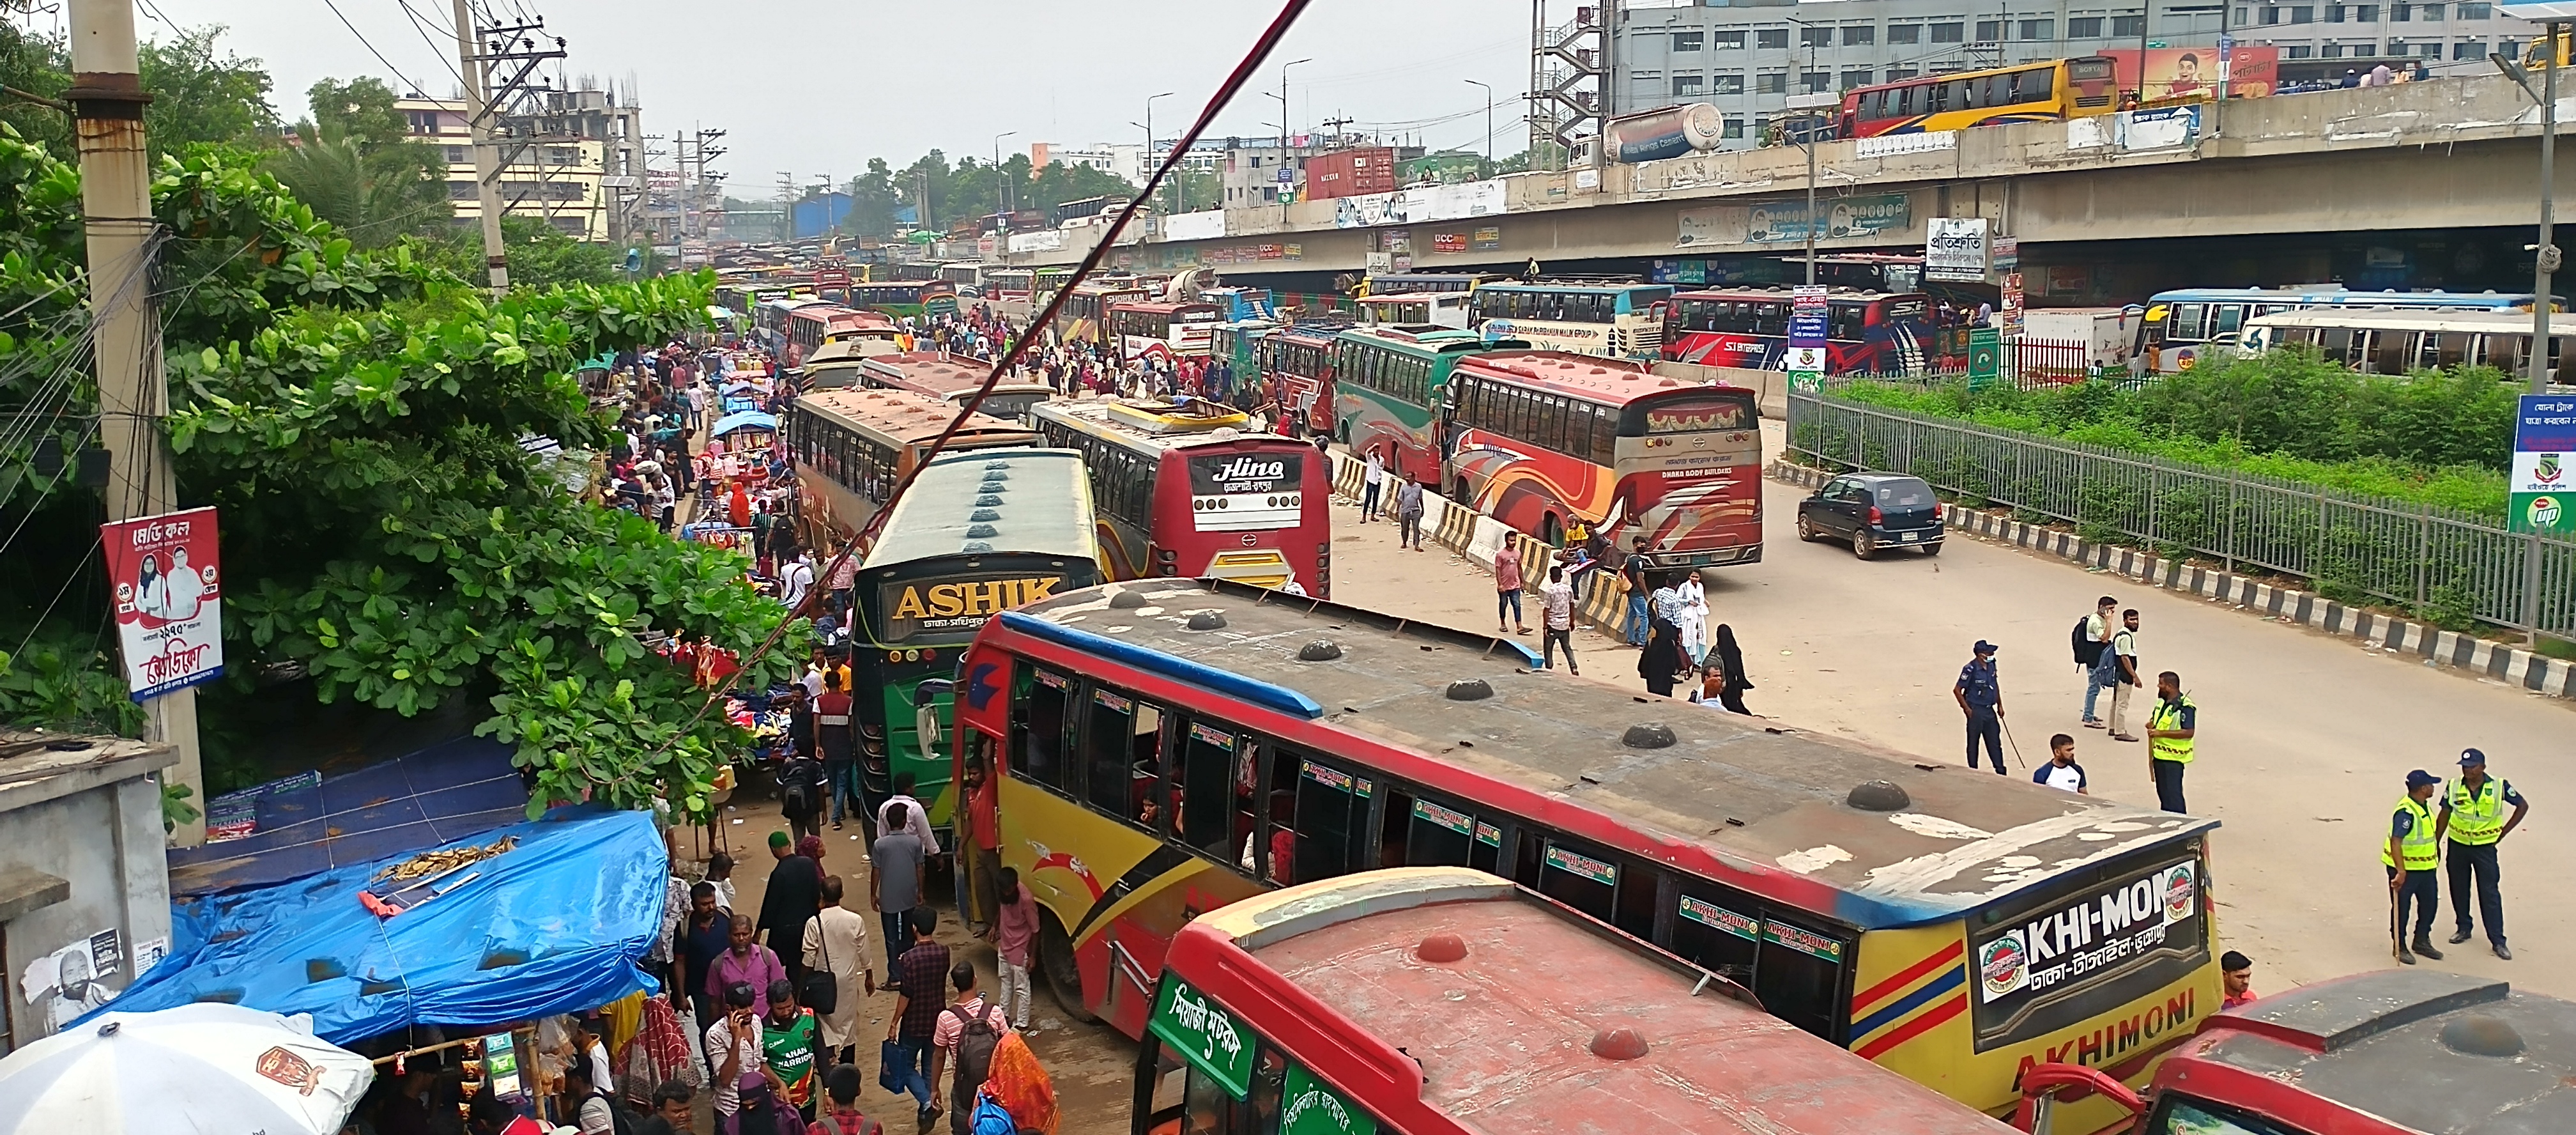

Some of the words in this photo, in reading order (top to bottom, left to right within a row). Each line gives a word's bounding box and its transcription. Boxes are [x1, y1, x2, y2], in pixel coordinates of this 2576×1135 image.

[1435, 234, 1453, 242] UCC
[1930, 233, 1982, 250] প্রতিশ্রুতি
[1107, 293, 1144, 304] SHORKAR
[1213, 458, 1284, 482] Hino
[1685, 468, 1703, 477] BODY
[1704, 467, 1732, 475] BUILDERS
[892, 577, 1060, 619] ASHIK
[1556, 850, 1607, 875] AKHI-MONI
[1690, 902, 1749, 930] AKHI-MONI
[1767, 922, 1830, 951] AKHI-MONI
[1169, 983, 1206, 1033] মিয়াজী
